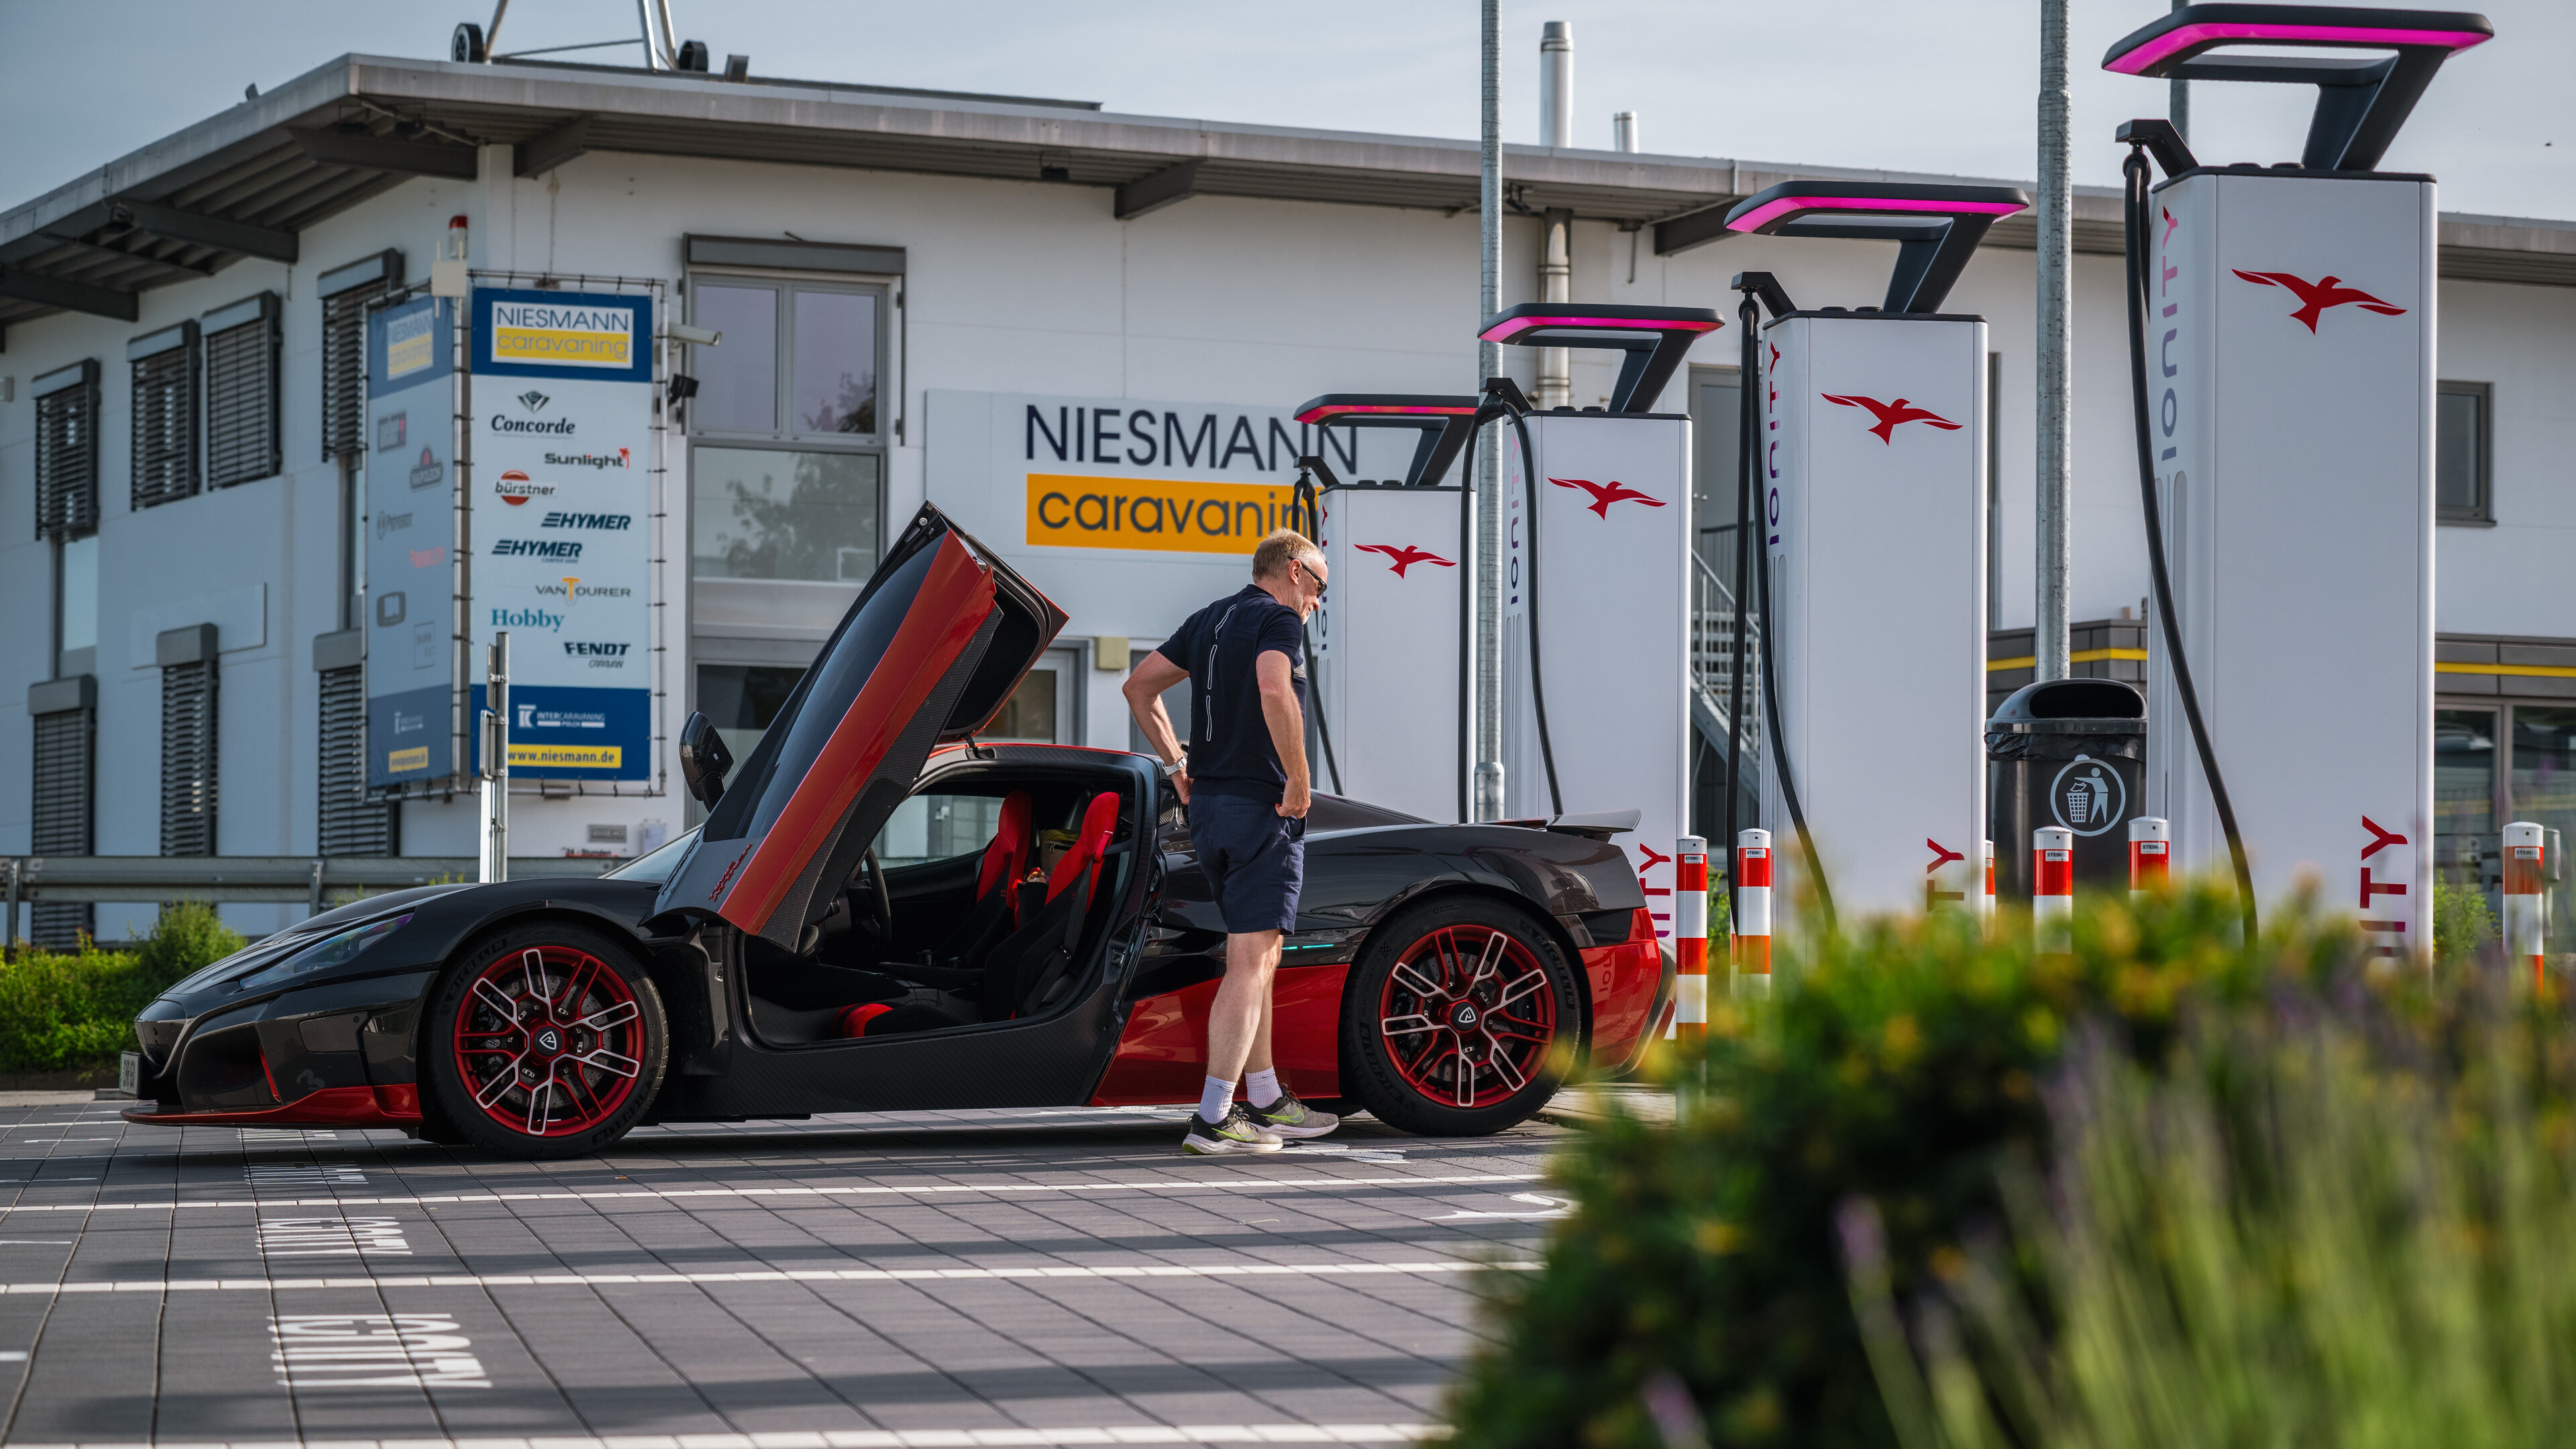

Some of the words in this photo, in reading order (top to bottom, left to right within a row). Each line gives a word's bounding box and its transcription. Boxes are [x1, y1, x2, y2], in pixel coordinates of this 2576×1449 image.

[497, 307, 629, 332] NIESMANN
[497, 335, 629, 360] caravaning
[490, 414, 576, 435] Concorde
[1026, 404, 1357, 476] NIESMANN
[544, 452, 624, 470] Sunlight
[494, 480, 556, 496] bürstner
[490, 608, 566, 633] Hobby
[564, 641, 631, 656] FENDT
[508, 749, 615, 763] www.niesmann.de
